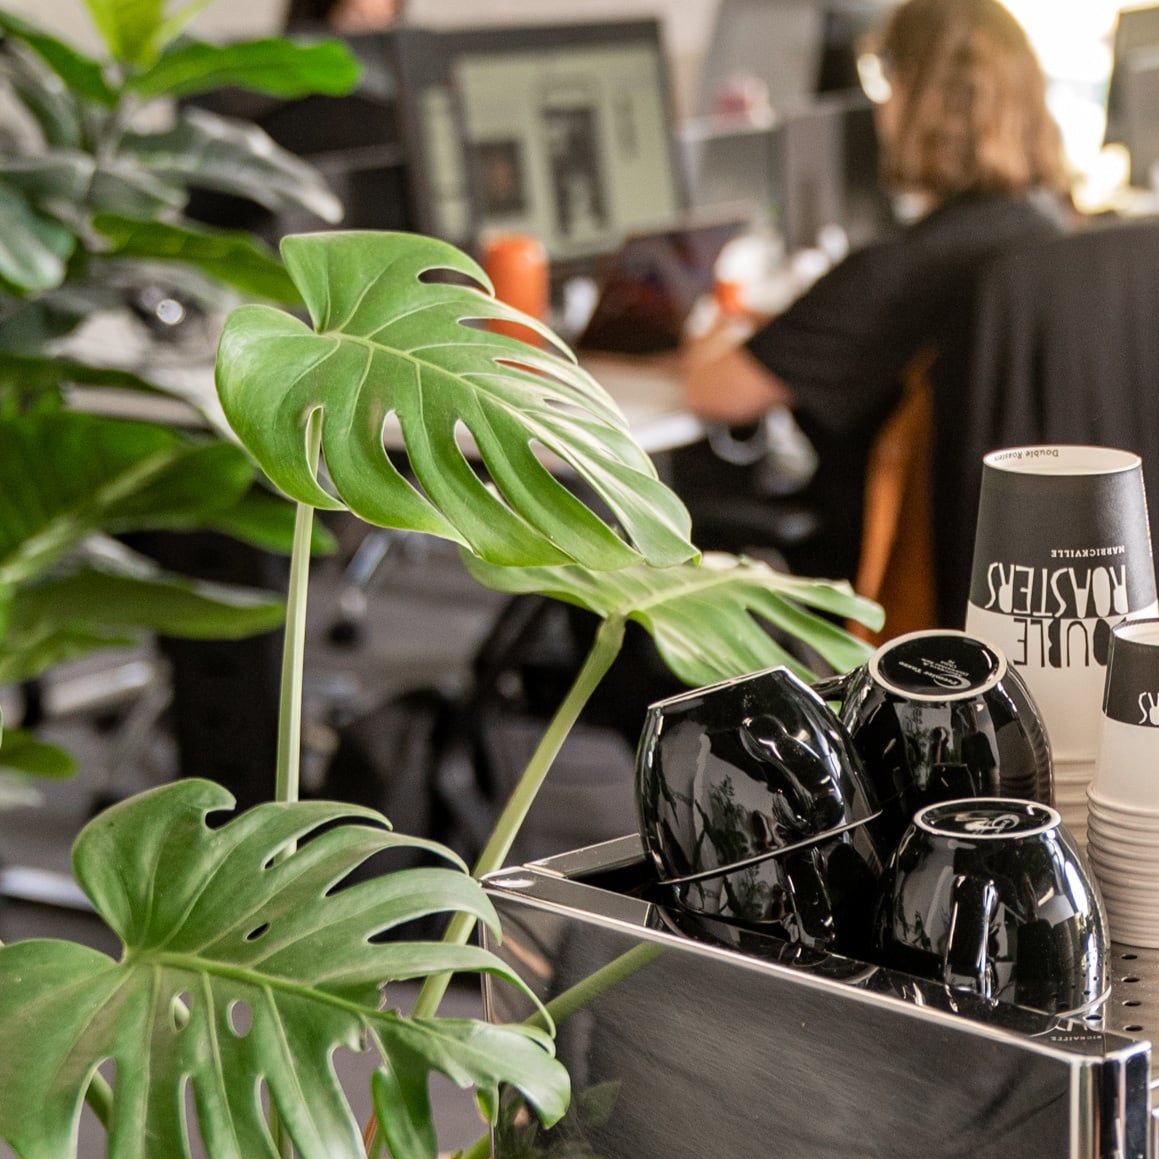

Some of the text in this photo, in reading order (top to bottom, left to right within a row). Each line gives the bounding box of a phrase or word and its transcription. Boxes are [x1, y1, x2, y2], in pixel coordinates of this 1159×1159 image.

[1026, 448, 1059, 457] Double
[1051, 545, 1125, 558] MARRICKVILLE
[985, 562, 1129, 619] ROASTERS
[1013, 617, 1127, 669] OUBLE
